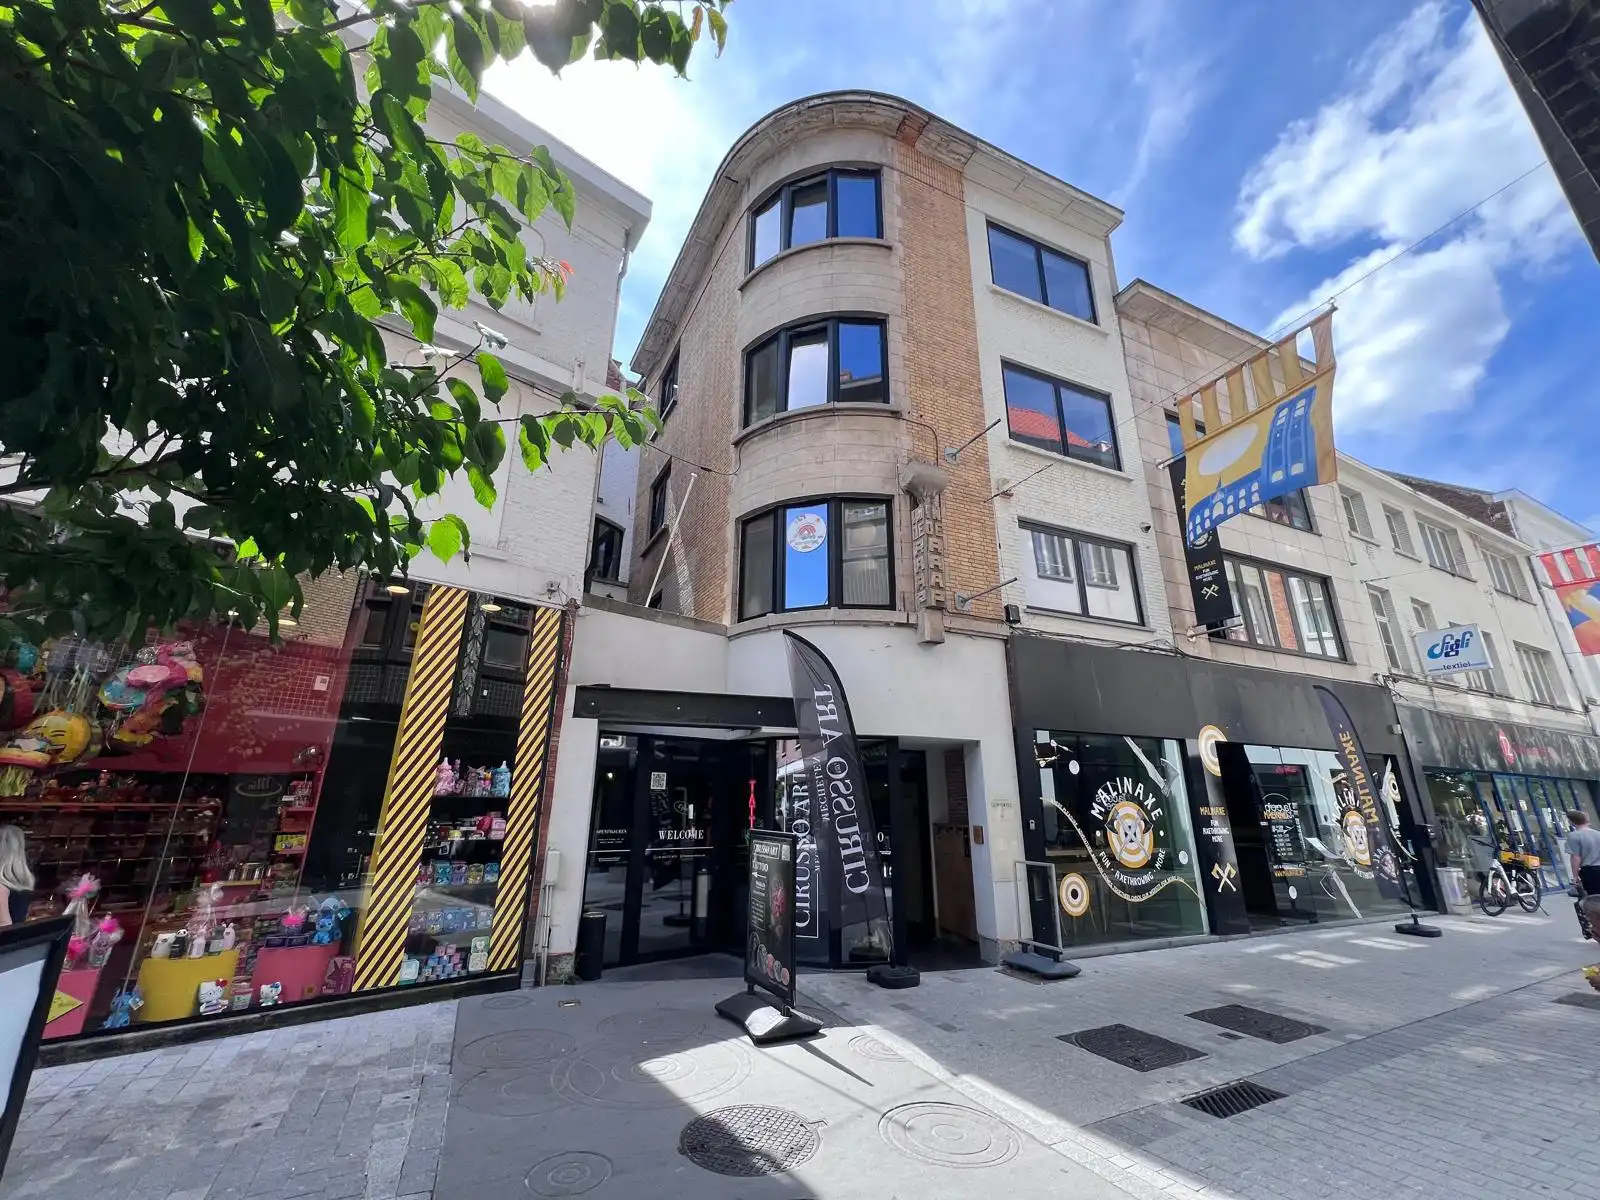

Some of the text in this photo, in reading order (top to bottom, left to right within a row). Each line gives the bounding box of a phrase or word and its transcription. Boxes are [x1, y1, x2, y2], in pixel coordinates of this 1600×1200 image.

[1193, 559, 1217, 571] MALINAXE
[1443, 661, 1471, 671] textiel
[792, 771, 811, 812] ART
[1090, 776, 1163, 820] MALINAXE
[1199, 806, 1226, 816] MALINAXE
[1210, 819, 1219, 827] FUN
[658, 829, 704, 840] WELCOME
[1202, 827, 1230, 835] AXETHROWING
[1211, 835, 1223, 843] MORE
[1099, 850, 1111, 868] FUN
[1114, 870, 1154, 886] AXETHROWING
[1154, 848, 1166, 870] MORE
